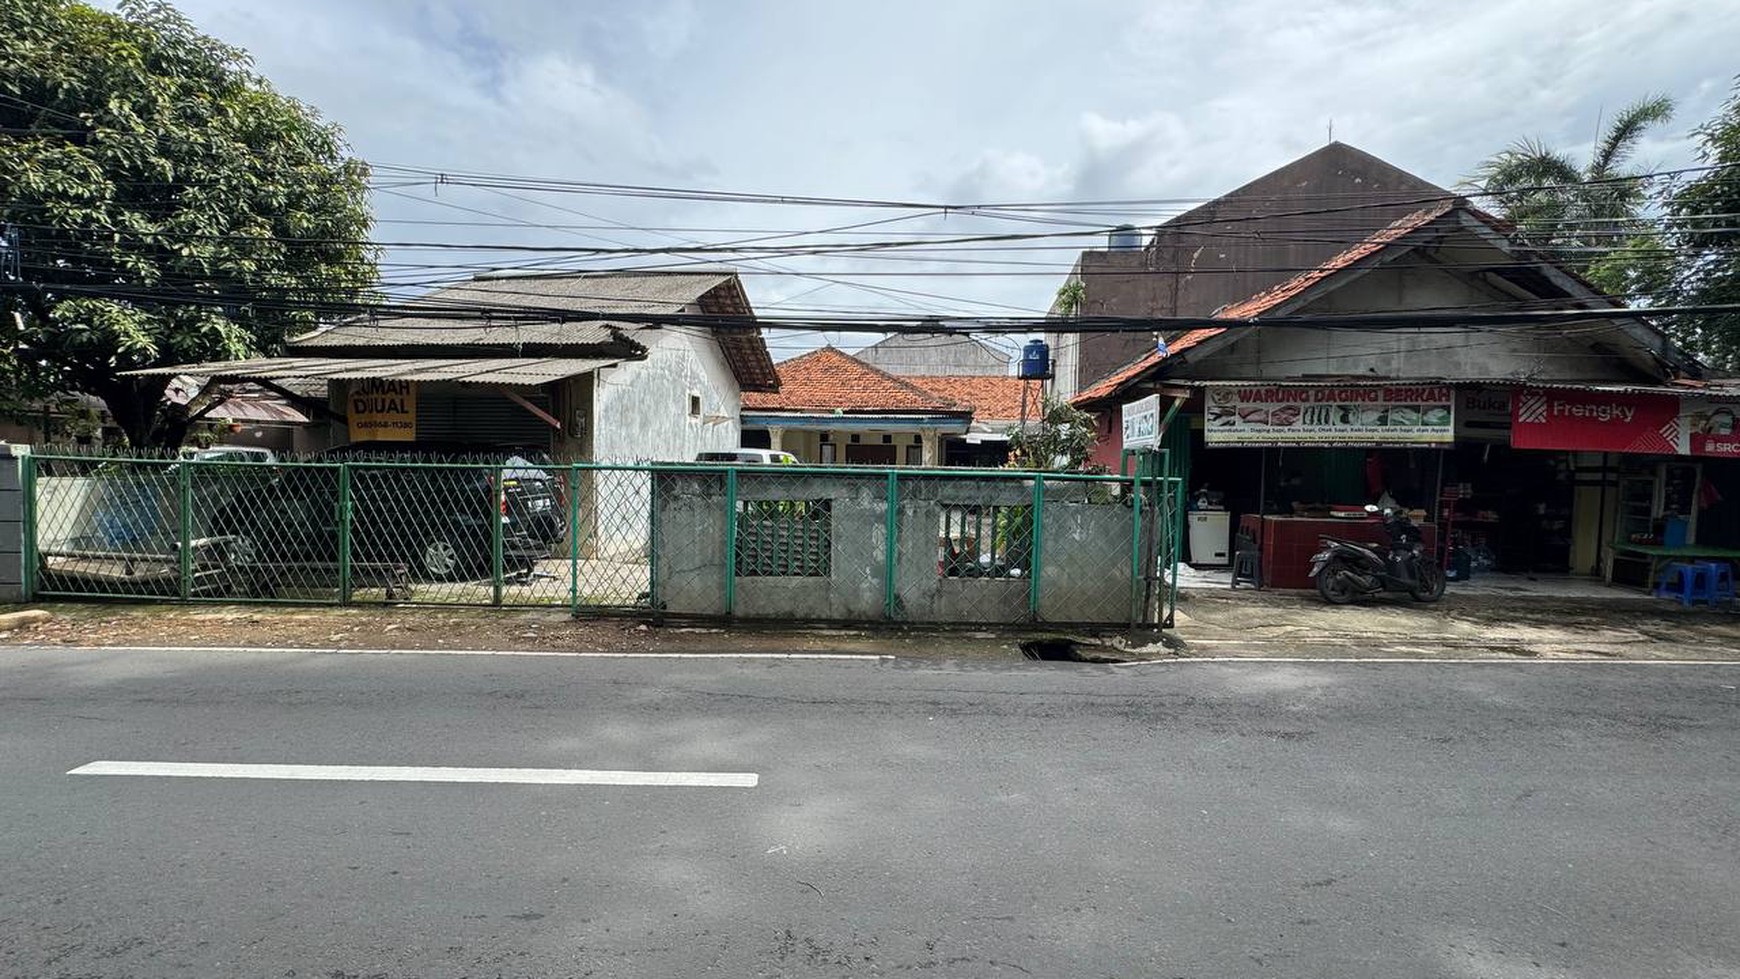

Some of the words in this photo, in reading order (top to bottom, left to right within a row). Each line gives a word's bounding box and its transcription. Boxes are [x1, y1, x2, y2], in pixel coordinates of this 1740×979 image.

[1238, 388, 1309, 403] WARUNG
[1314, 388, 1379, 403] DAGING
[1383, 387, 1450, 403] BERKAH
[1553, 400, 1636, 422] Frengky
[1716, 442, 1740, 453] SRC
